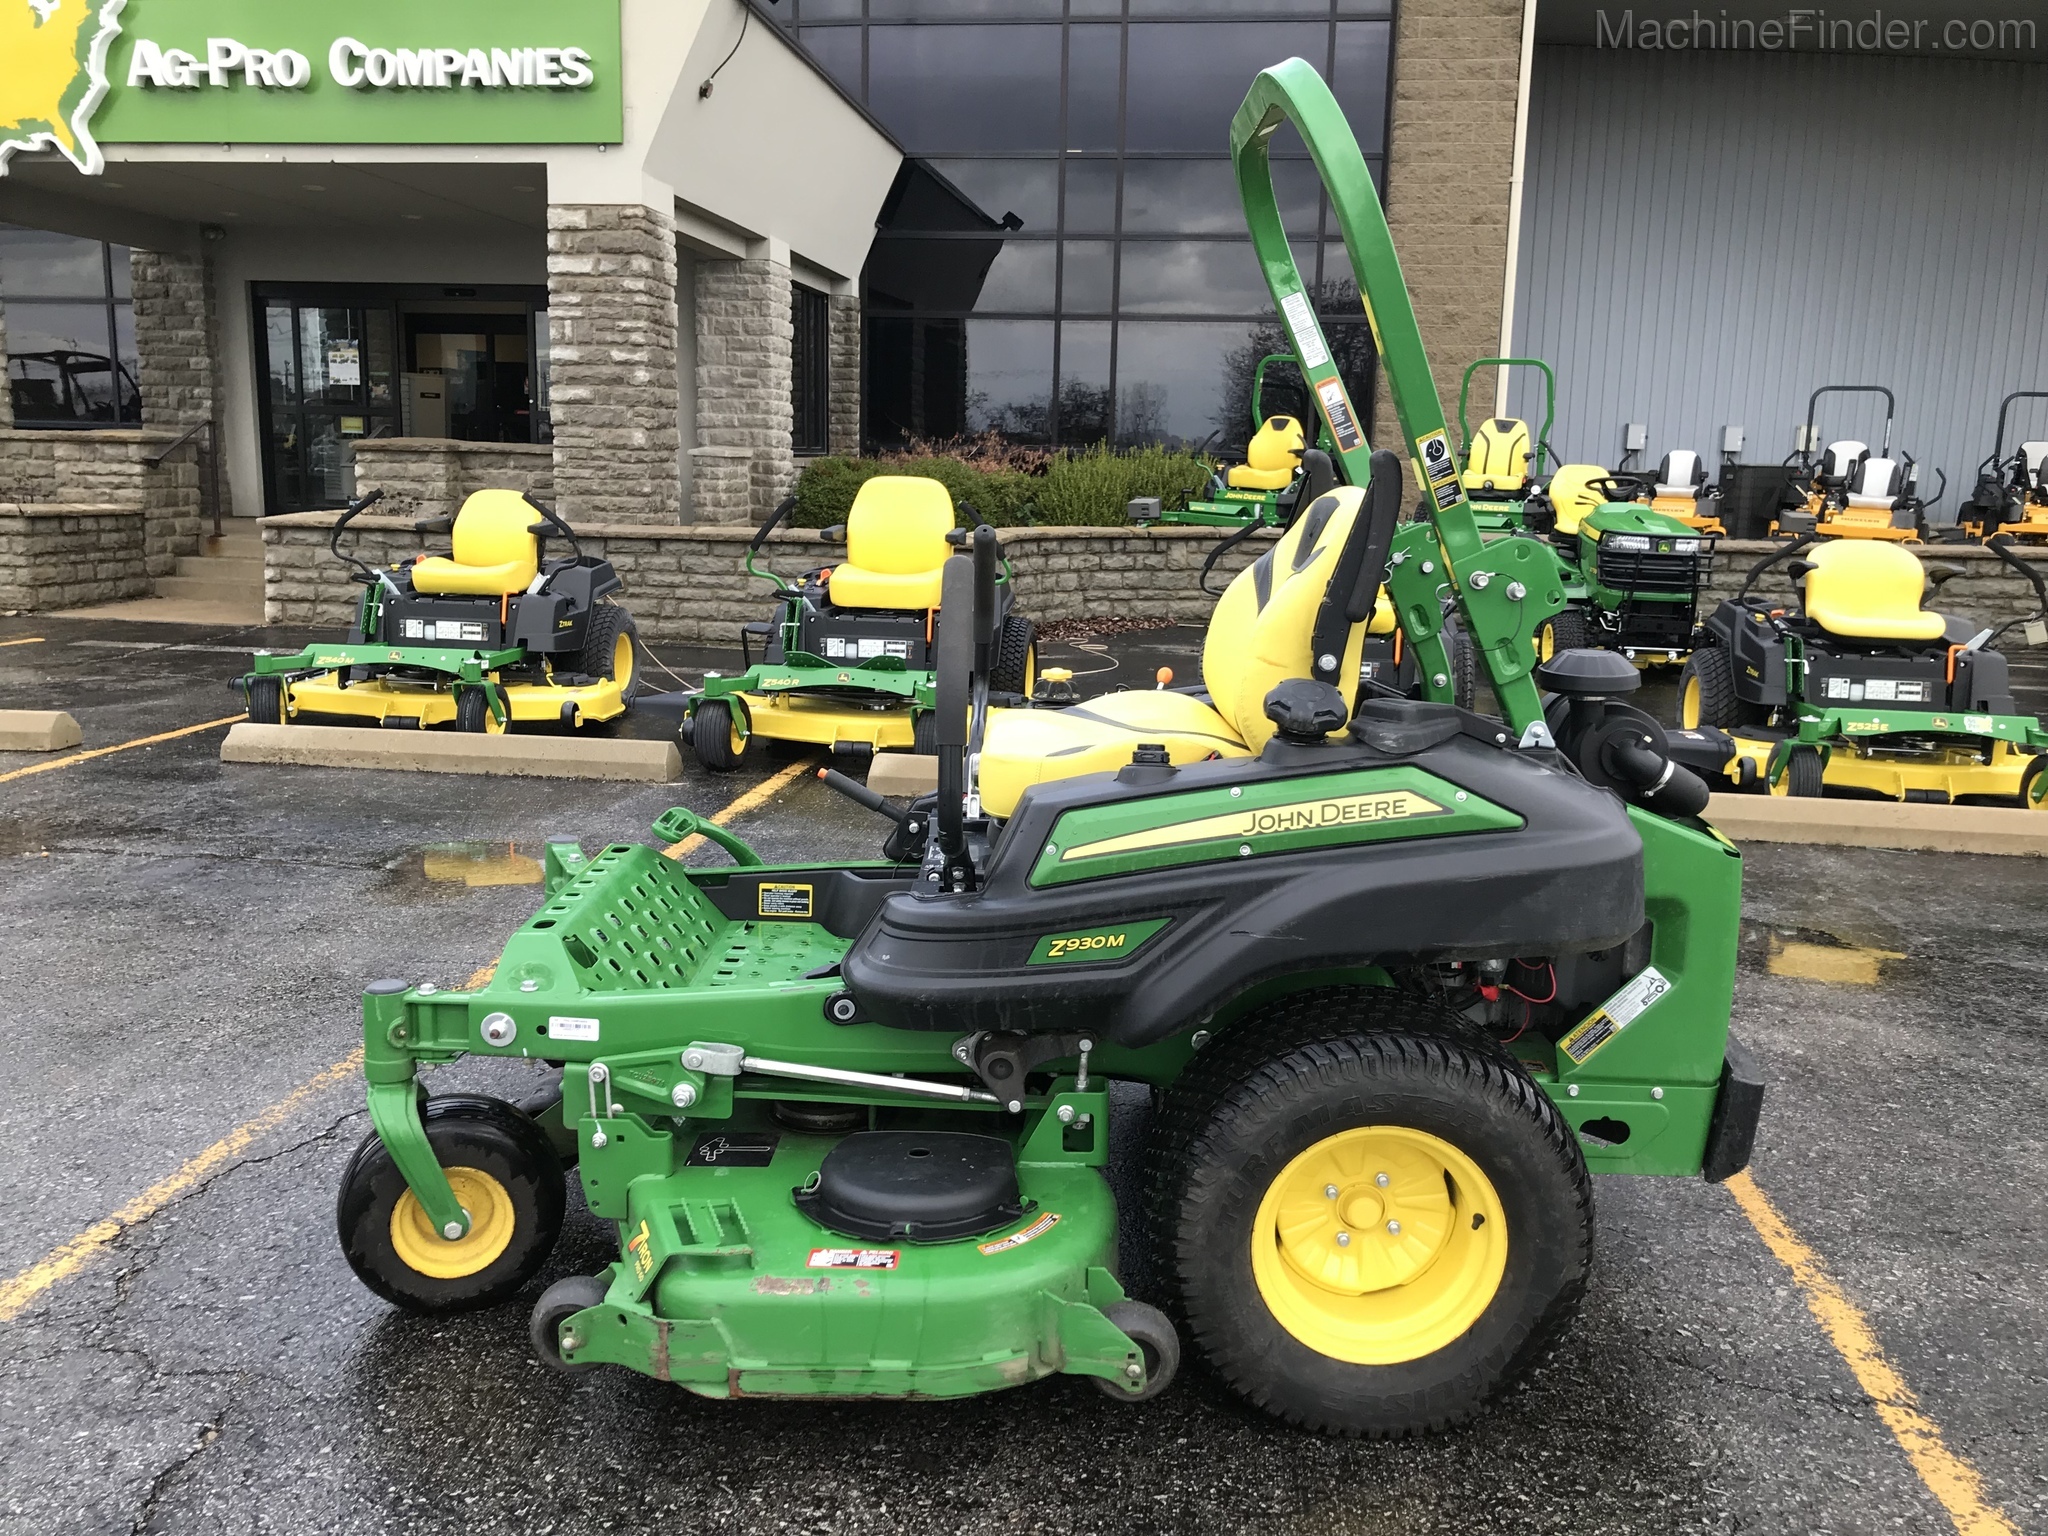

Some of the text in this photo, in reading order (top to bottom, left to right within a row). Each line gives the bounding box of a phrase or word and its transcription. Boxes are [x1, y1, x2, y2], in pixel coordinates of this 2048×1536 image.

[328, 36, 594, 88] COMPANIES
[1483, 504, 1510, 512] DEERE
[1243, 799, 1407, 834] JOHN DEERE
